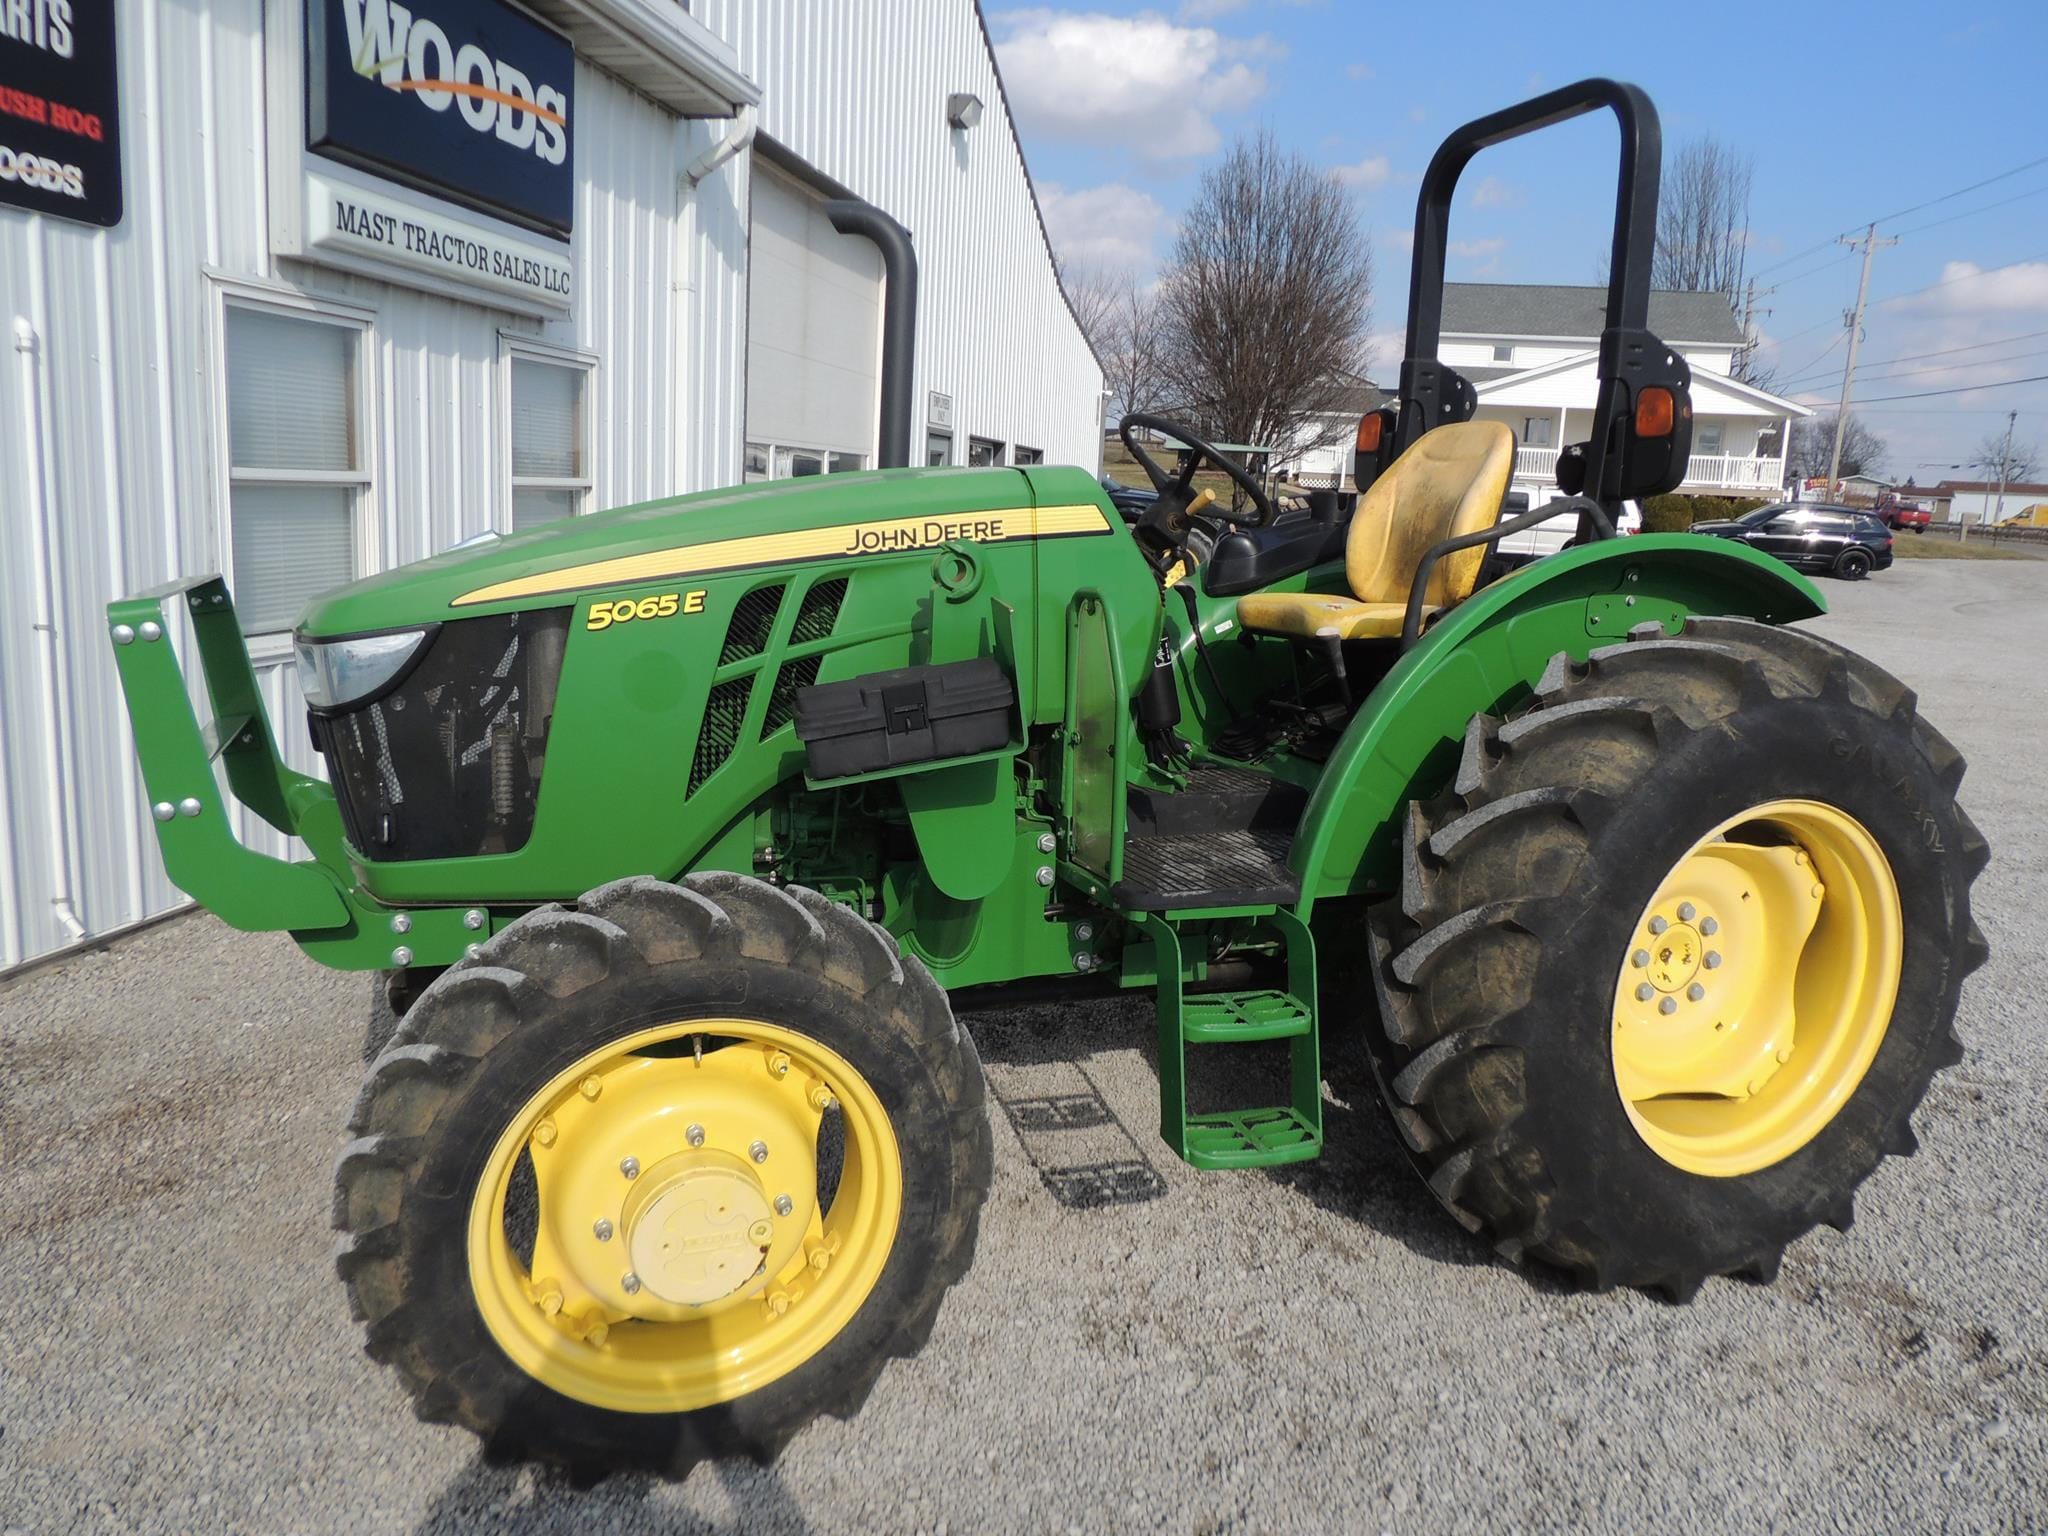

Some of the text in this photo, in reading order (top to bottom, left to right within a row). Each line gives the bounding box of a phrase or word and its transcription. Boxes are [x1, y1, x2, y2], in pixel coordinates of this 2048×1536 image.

[343, 0, 567, 165] WOODS
[49, 101, 104, 141] HOG
[336, 201, 570, 295] MAST TRACTOR SALES LLC
[846, 520, 1004, 551] JOHN DEERE
[586, 590, 707, 632] 5065 E
